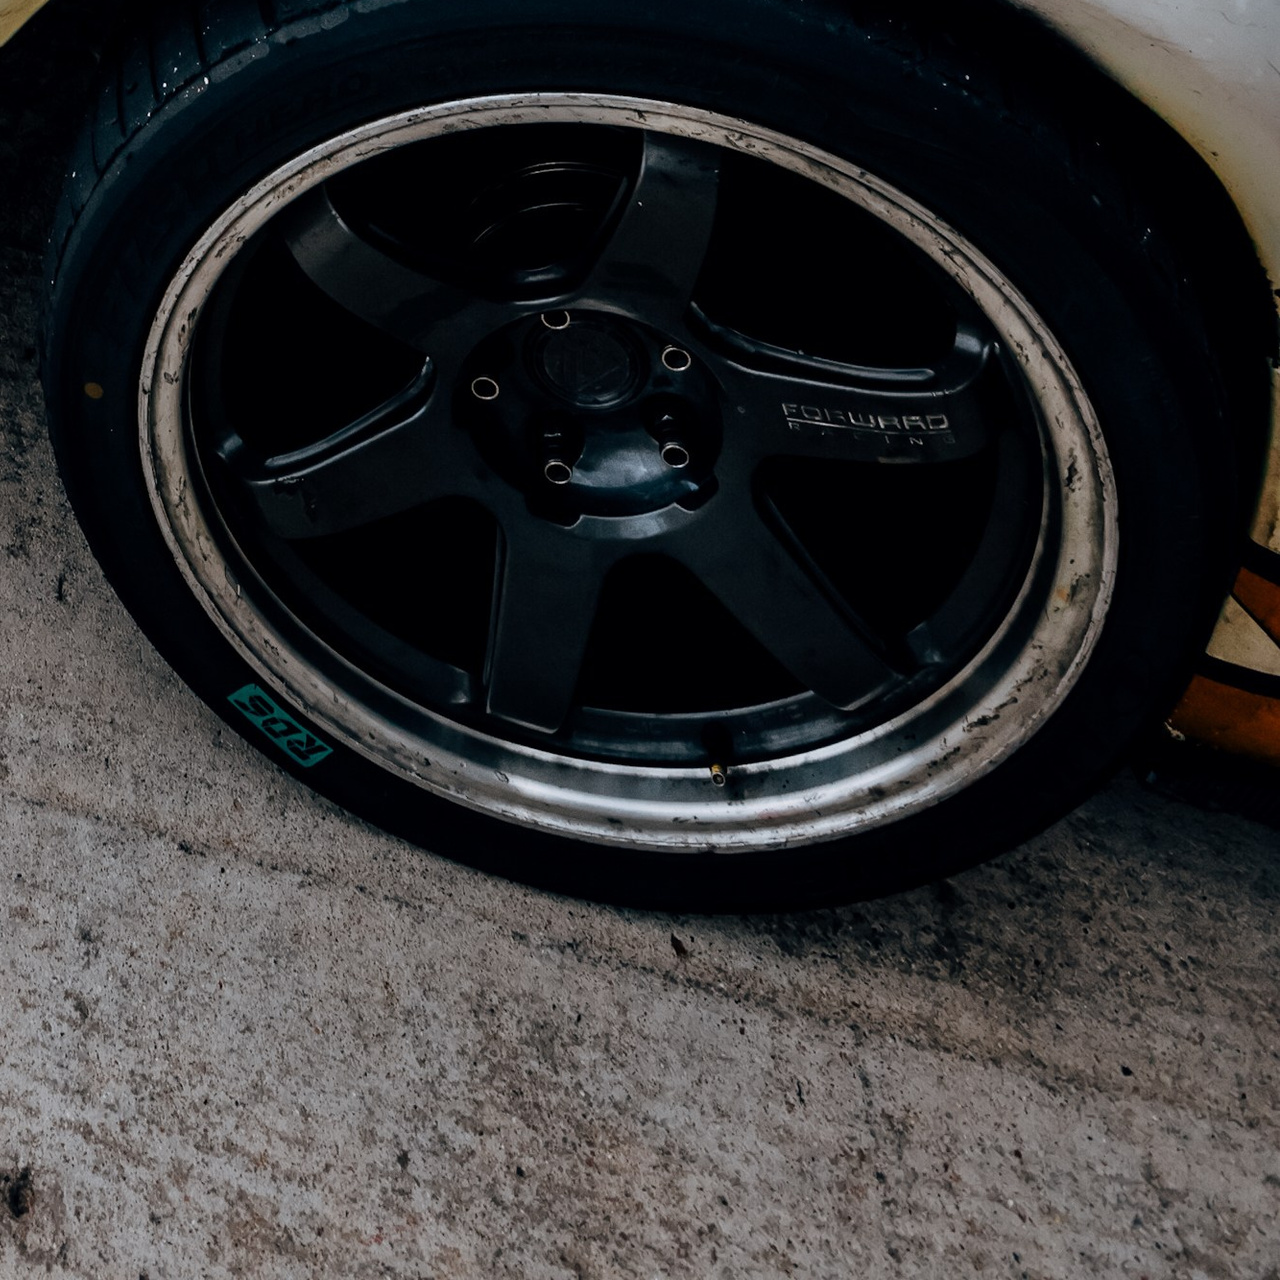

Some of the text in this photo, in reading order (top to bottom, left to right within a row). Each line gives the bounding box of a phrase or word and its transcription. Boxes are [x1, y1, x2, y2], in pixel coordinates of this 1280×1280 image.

[782, 403, 949, 430] FORWARD
[788, 422, 956, 445] RING
[233, 695, 329, 760] RDS
